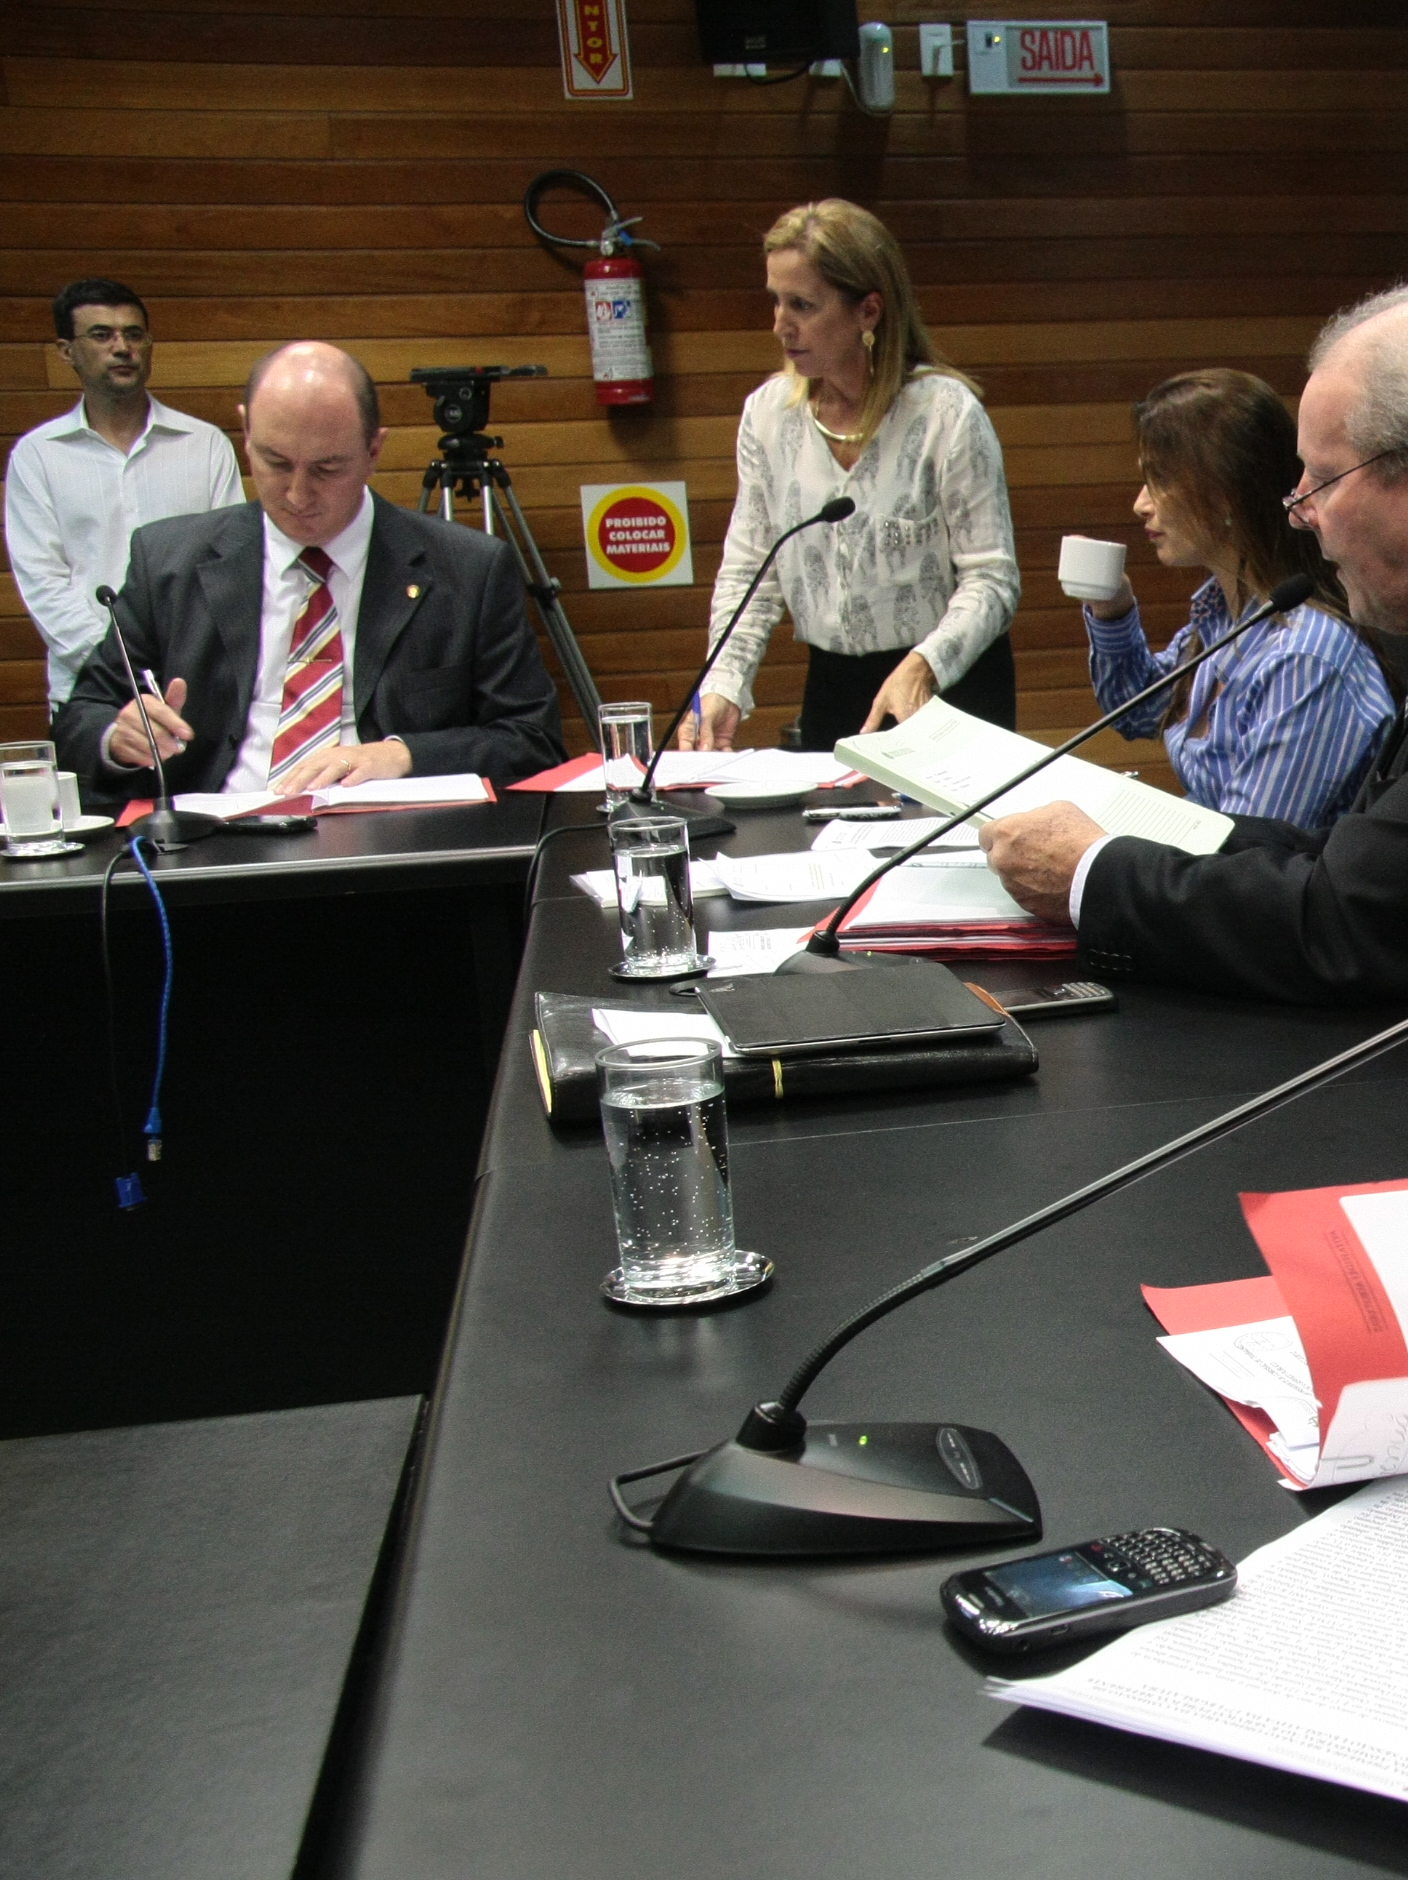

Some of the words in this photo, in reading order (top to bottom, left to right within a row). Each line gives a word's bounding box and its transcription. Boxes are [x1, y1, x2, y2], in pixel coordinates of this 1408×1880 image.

[605, 515, 667, 528] PROIBIDO
[609, 529, 665, 541] COLOCAR
[606, 542, 671, 554] MATERIAIS
